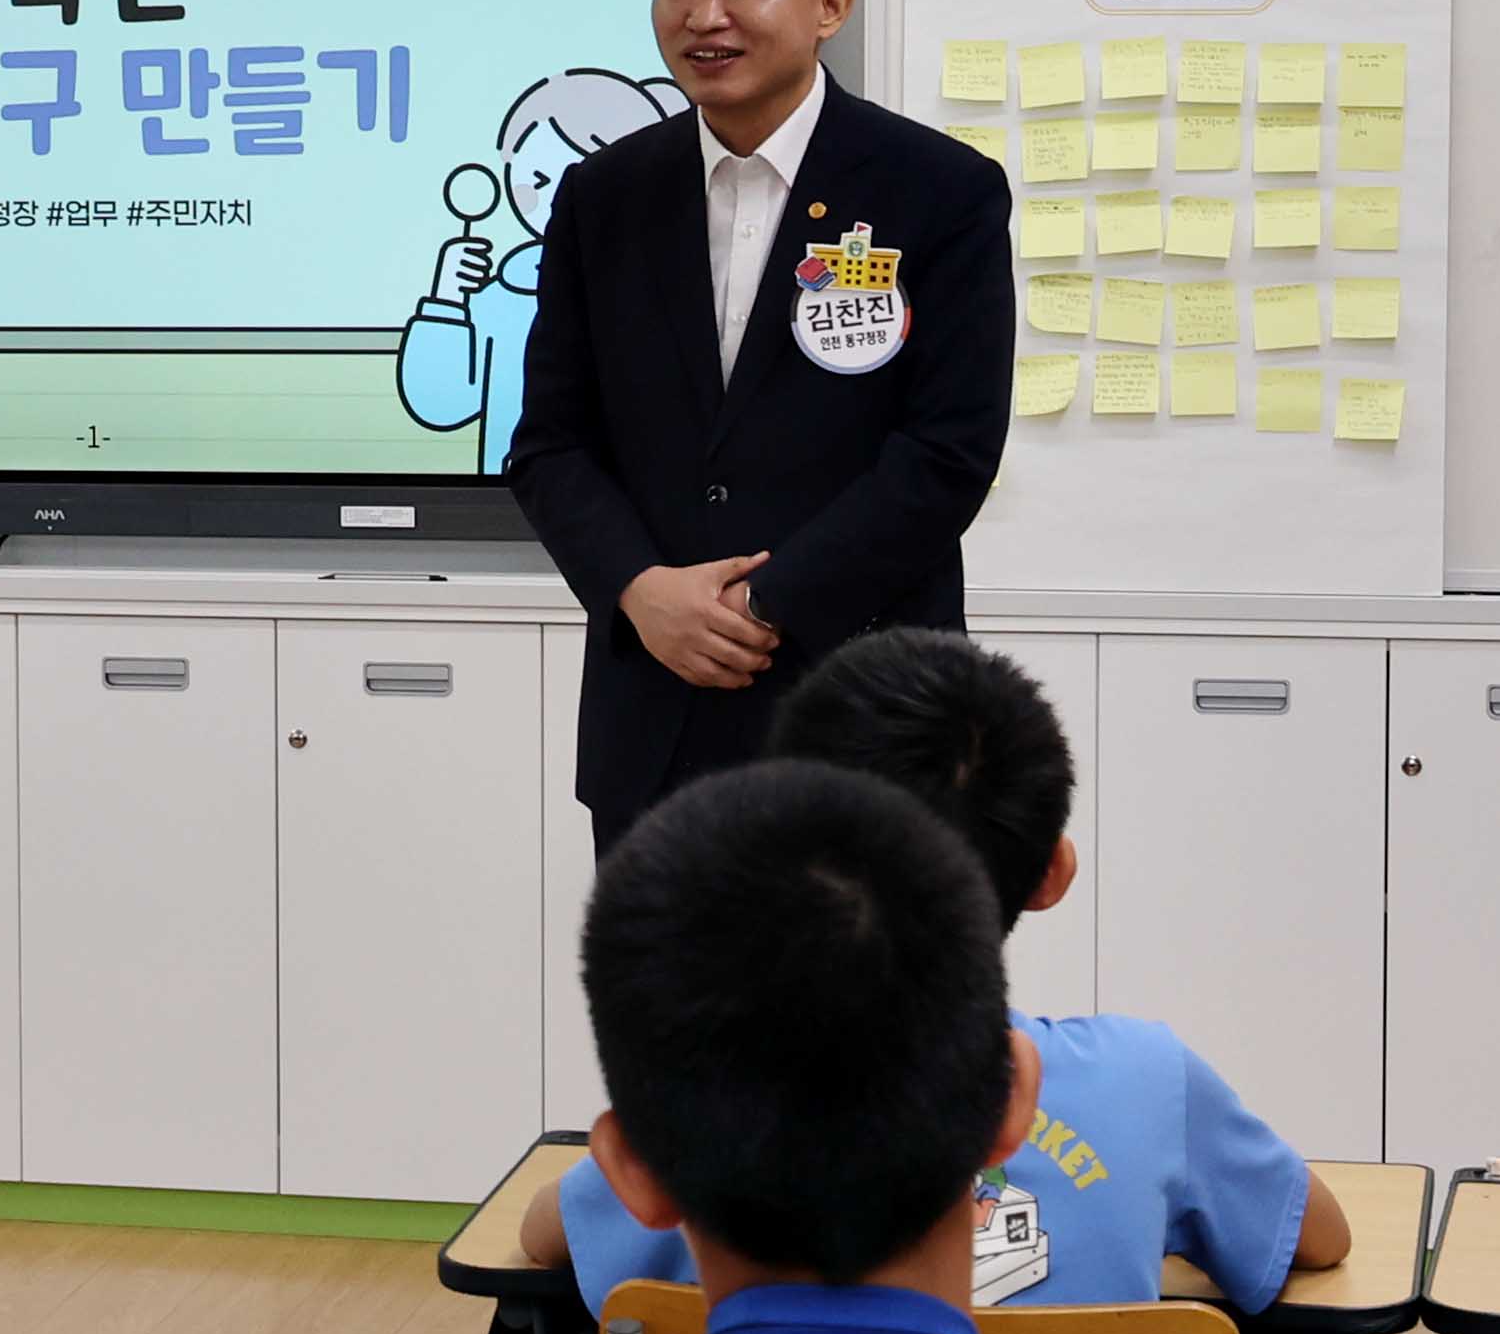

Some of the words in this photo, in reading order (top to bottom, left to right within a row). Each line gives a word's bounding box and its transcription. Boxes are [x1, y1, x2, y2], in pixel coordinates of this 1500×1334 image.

[120, 45, 411, 156] 만들기
[47, 200, 119, 227] #업무
[126, 199, 253, 227] #주민자치
[805, 293, 895, 332] 김찬진
[820, 335, 842, 351] 인천
[845, 329, 887, 349] 동구청장
